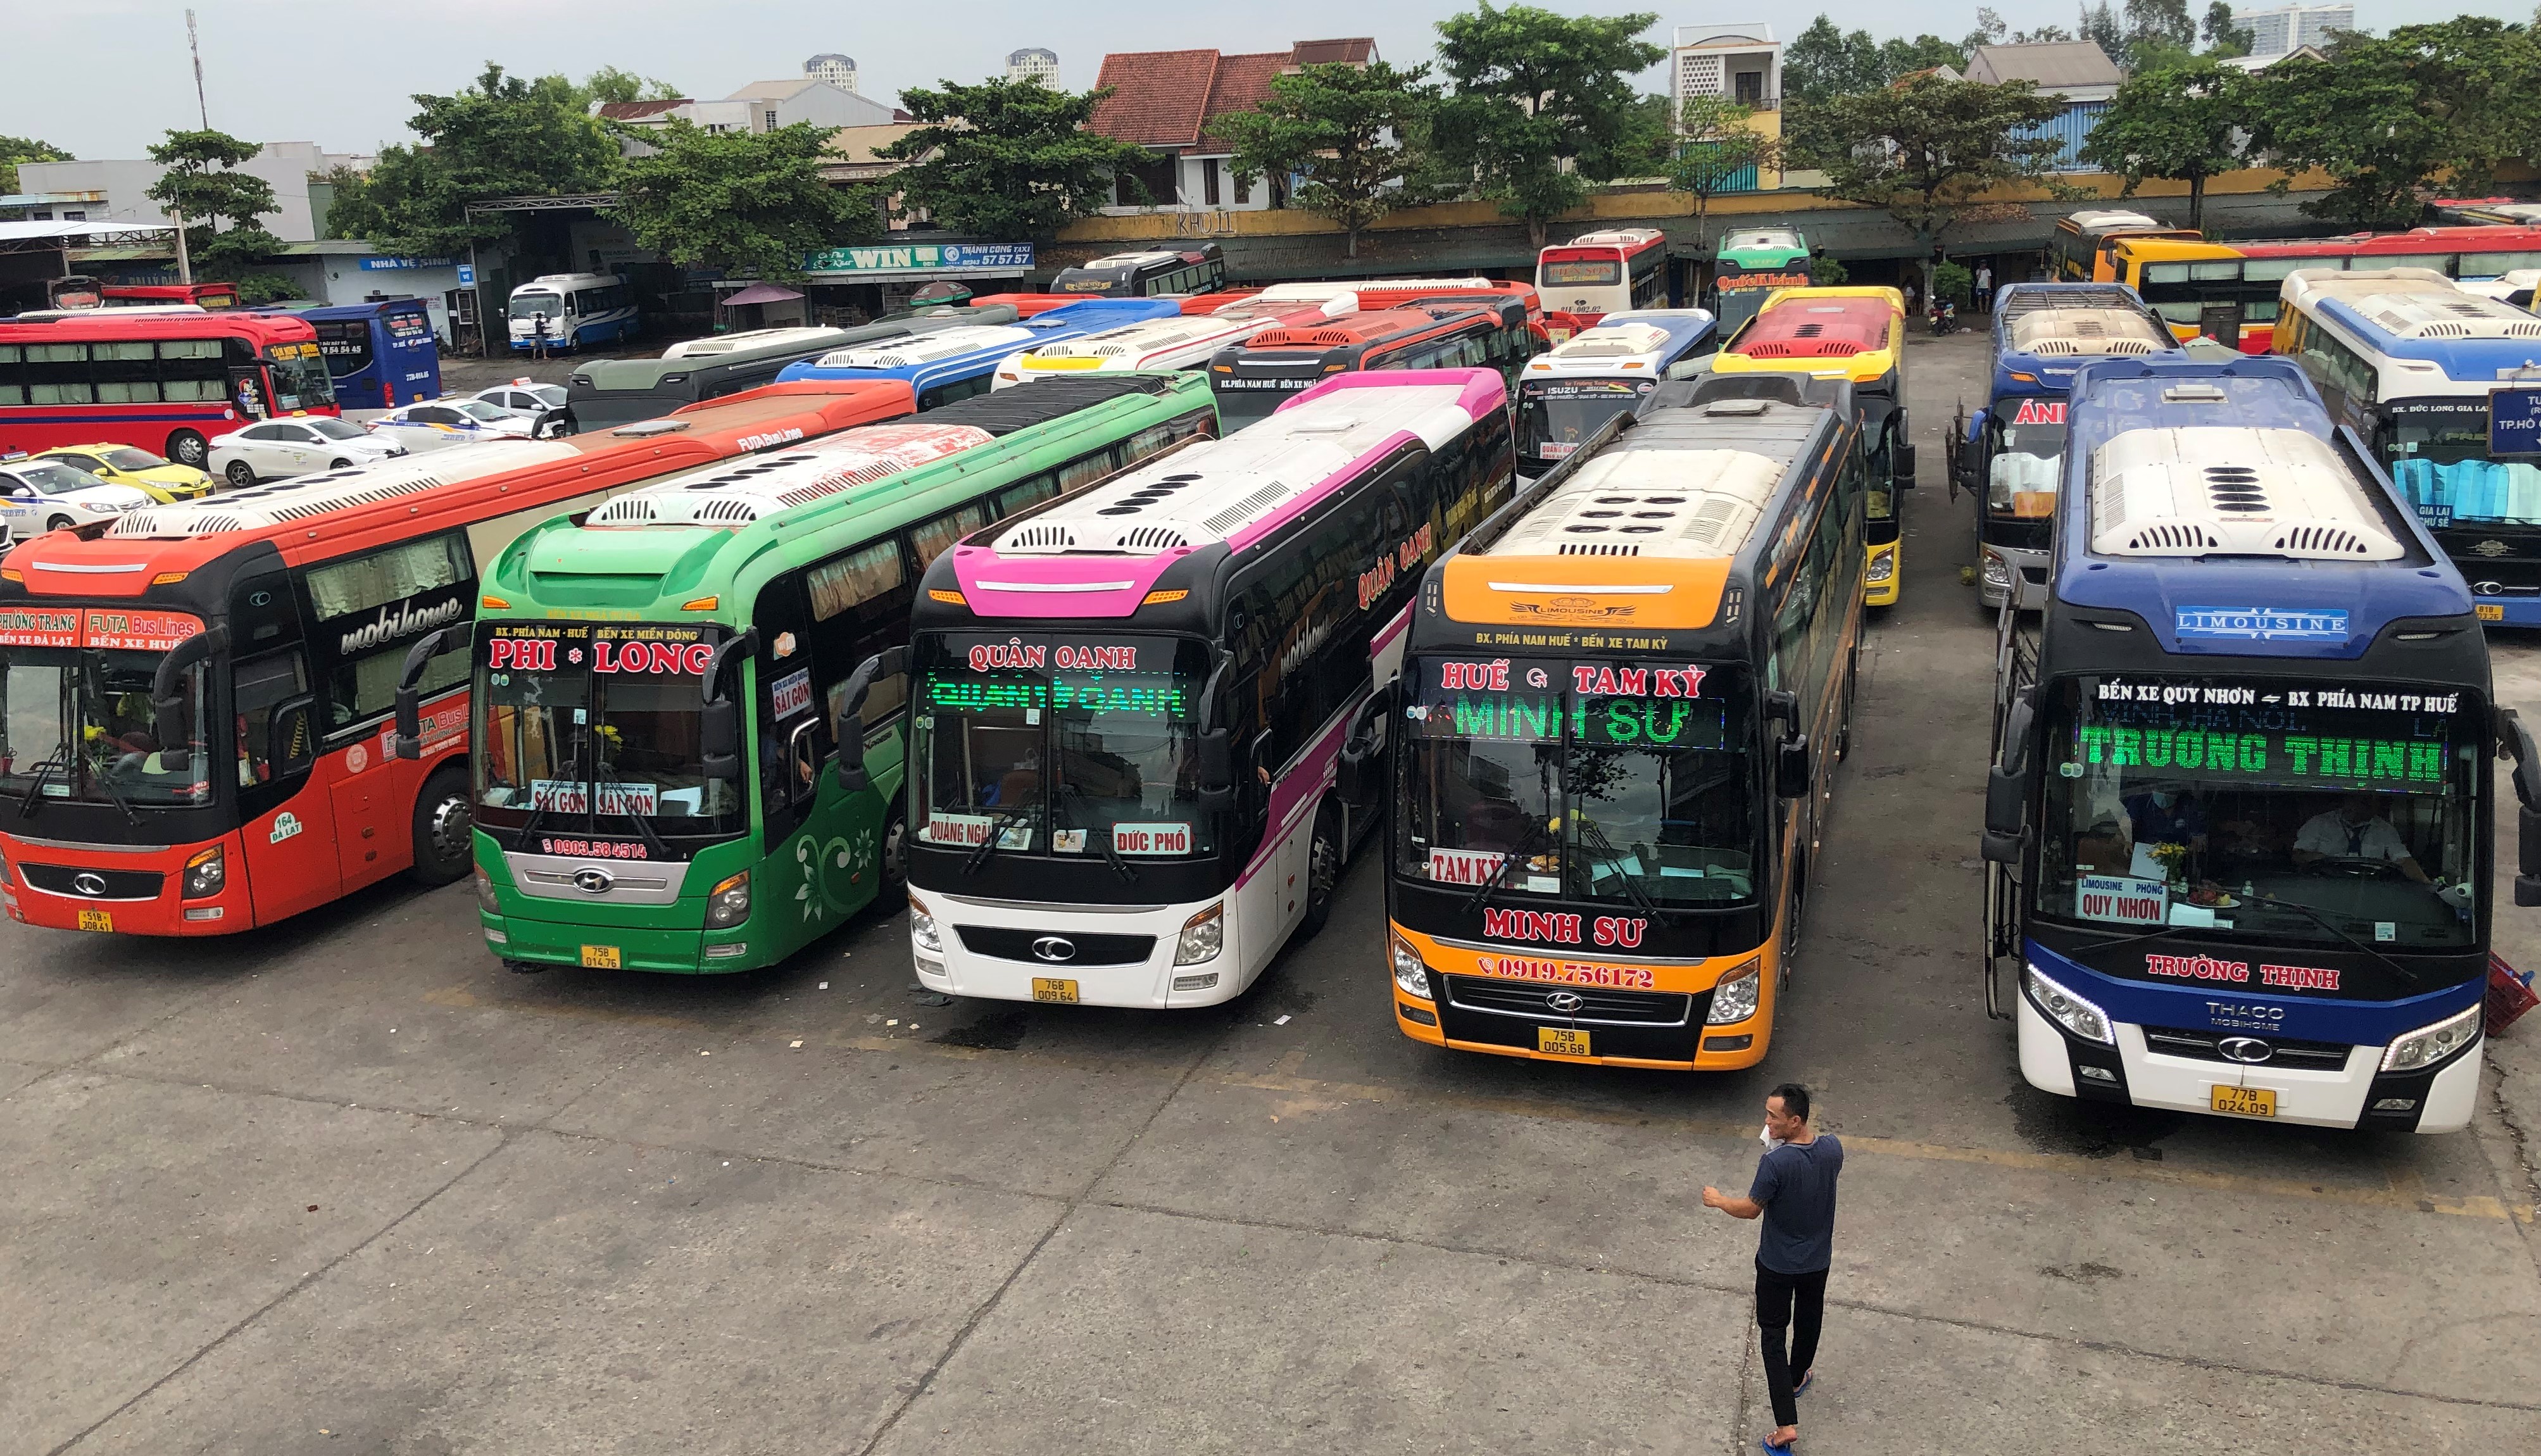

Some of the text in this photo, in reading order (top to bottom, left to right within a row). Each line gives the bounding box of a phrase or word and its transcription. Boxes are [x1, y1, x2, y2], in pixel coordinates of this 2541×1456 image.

[1177, 212, 1212, 236] KHO
[399, 258, 416, 269] VỆ
[850, 248, 912, 268] WIN
[982, 255, 997, 265] 57
[998, 254, 1013, 264] 57
[1014, 254, 1029, 264] 57
[1246, 380, 1262, 388] NAM
[1262, 379, 1276, 389] HUẾ
[1279, 378, 1293, 389] BẾN
[1293, 380, 1303, 389] XE
[1547, 386, 1578, 394] ISUZU
[2409, 404, 2428, 412] ĐỨC
[737, 435, 764, 452] FUTA
[778, 427, 804, 442] Lines
[2419, 506, 2450, 516] GIA LAI
[1358, 552, 1395, 611] QUÂN
[1399, 522, 1432, 572] OANH
[1540, 605, 1605, 615] LIMOUSINE
[38, 613, 76, 632] TRANG
[89, 615, 196, 637] FUTA Bus Lines
[341, 596, 463, 655] mobihome
[2178, 615, 2346, 632] LIMOUSINE
[18, 636, 32, 645] XE
[90, 634, 120, 648] BẾN
[123, 639, 146, 648] XE
[513, 625, 536, 637] PHÍA
[538, 629, 560, 638] NAM
[568, 625, 589, 639] HUẾ
[596, 626, 618, 639] BẾN
[620, 629, 635, 639] XE
[637, 627, 664, 640] MIỀN
[666, 629, 699, 641] ĐÔNG
[1476, 631, 1668, 651] BX. PHÍA NAM HUẾ BẾN XE TAM KỲ
[489, 639, 714, 675] PHI LONG
[969, 637, 1137, 673] QUÂN OANH
[1441, 658, 1707, 698] HUẾ TAM KỲ
[775, 682, 809, 715] SÀI GÒN
[2098, 678, 2457, 713] BẾN XE QUY NHƠN BX PHÍA NAM TP HUẾ
[437, 709, 462, 729] Bus
[1456, 694, 1585, 739] MINH
[2284, 735, 2442, 787] THỊNH
[560, 791, 587, 814] GÒN
[599, 790, 653, 816] SÀI GÒN
[277, 814, 292, 828] 164
[931, 816, 964, 843] QUẢNG
[1117, 825, 1186, 851] ĐỨC PHỔ
[554, 839, 648, 859] 0903.584514
[1433, 855, 1471, 883] TAM
[2081, 879, 2163, 895] LIMOUSINE PHÒNG
[87, 912, 103, 922] 51B
[2083, 894, 2161, 921] QUY NHƠN
[83, 921, 109, 931] 308.41
[1484, 907, 1648, 948] MINH SƯ
[592, 948, 609, 957] 75B
[586, 958, 617, 968] 014.76
[1498, 958, 1653, 989] 0919.756172
[2147, 954, 2340, 992] TRƯỜNG THỊNH
[1045, 981, 1064, 991] 76B
[1038, 991, 1073, 1002] 009.64
[2206, 1002, 2285, 1020] THACO
[2210, 1018, 2280, 1031] MOBIHOME
[1553, 1030, 1575, 1041] 75B
[1543, 1041, 1585, 1055] 005.68
[2230, 1088, 2257, 1101] 77B
[2218, 1099, 2269, 1115] 024.09
